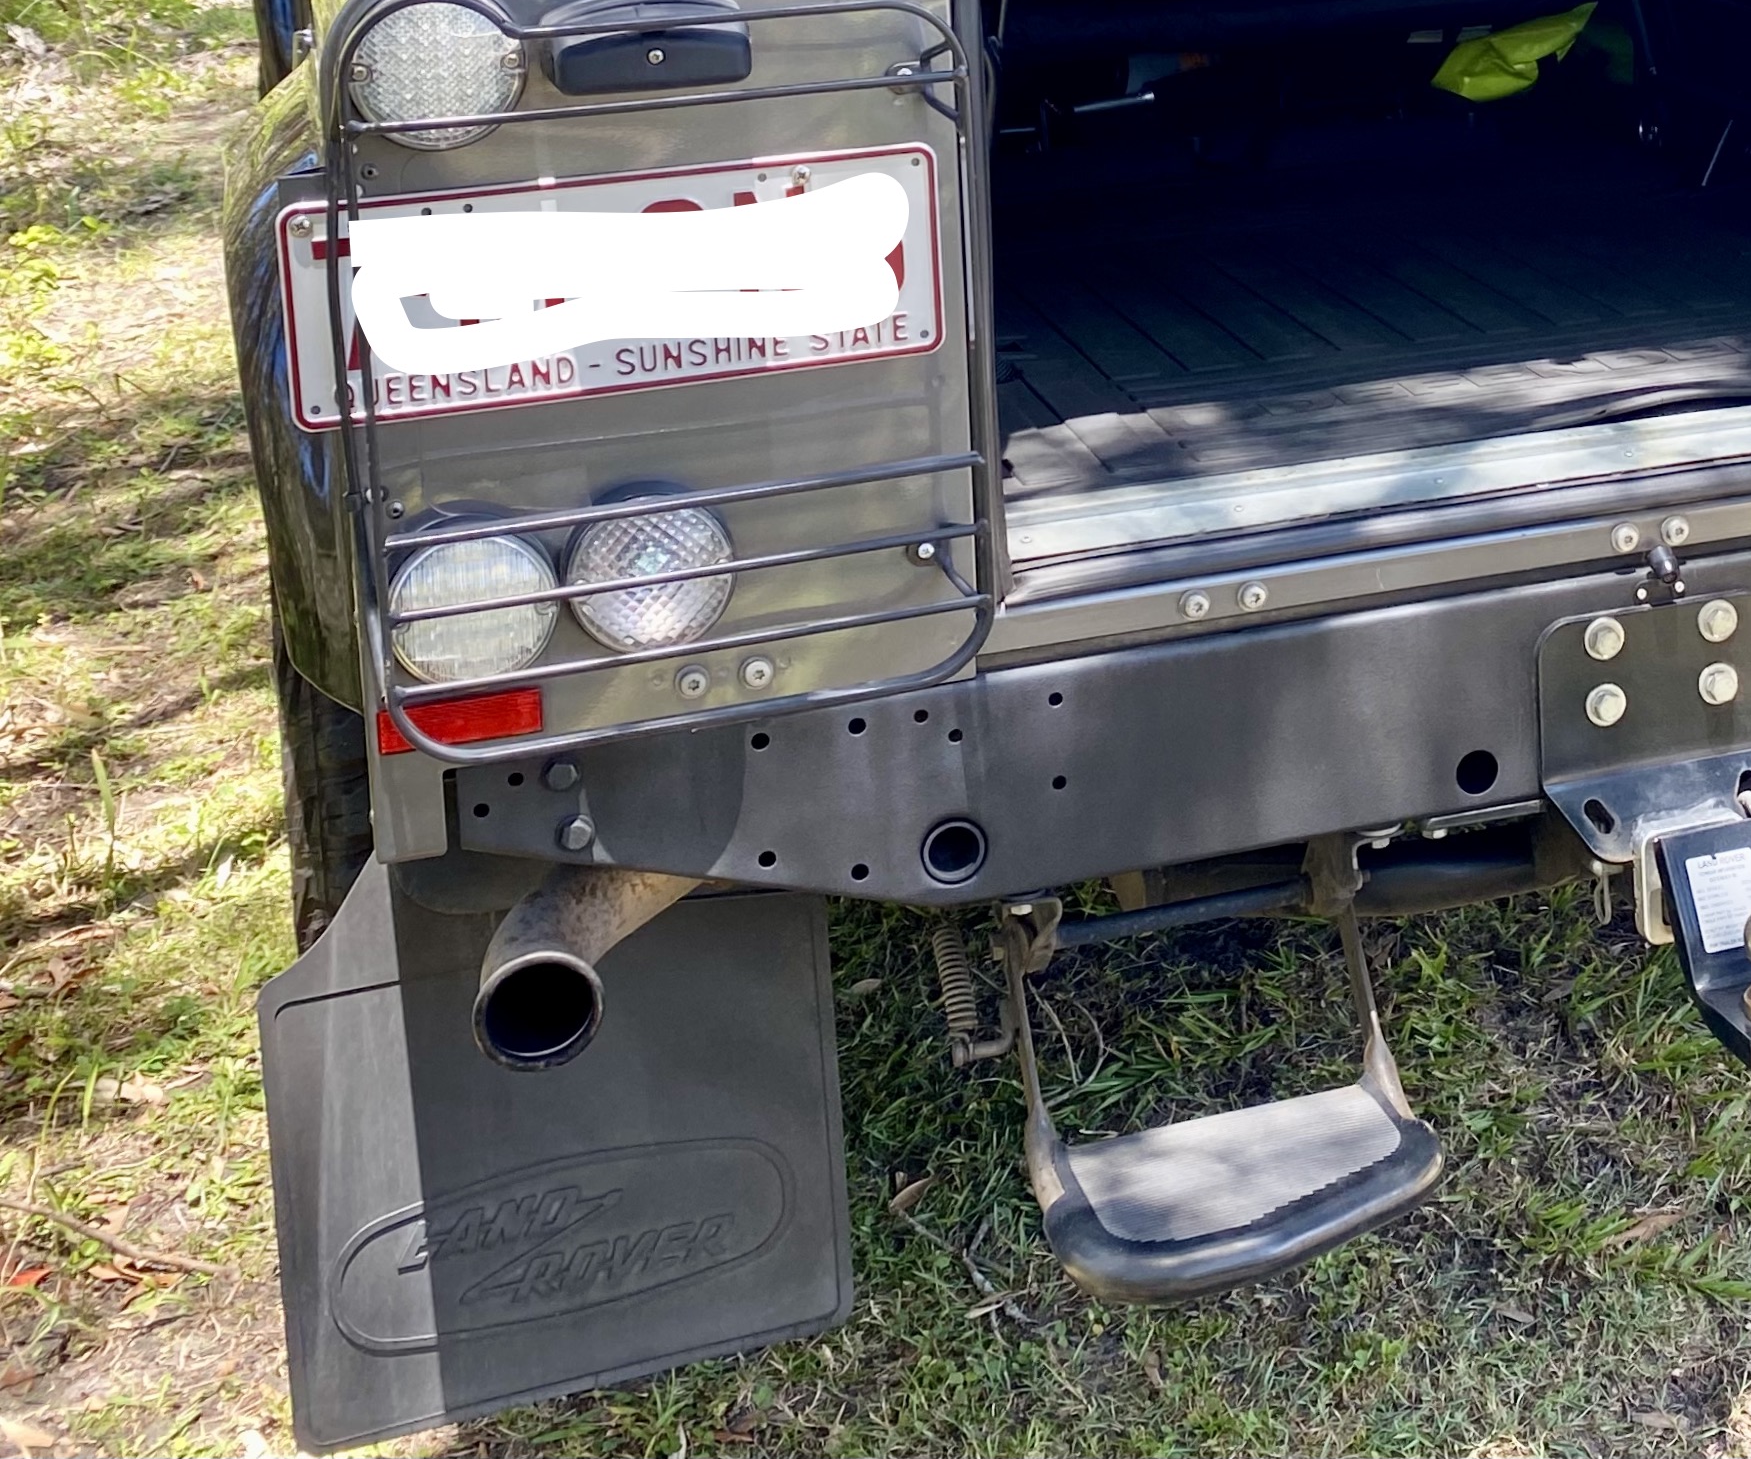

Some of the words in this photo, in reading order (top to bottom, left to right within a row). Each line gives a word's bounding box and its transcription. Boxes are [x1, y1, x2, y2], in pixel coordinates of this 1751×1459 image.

[615, 336, 790, 376] SUNSHINE
[397, 1184, 587, 1275] LAND
[503, 1211, 736, 1306] ROVER
